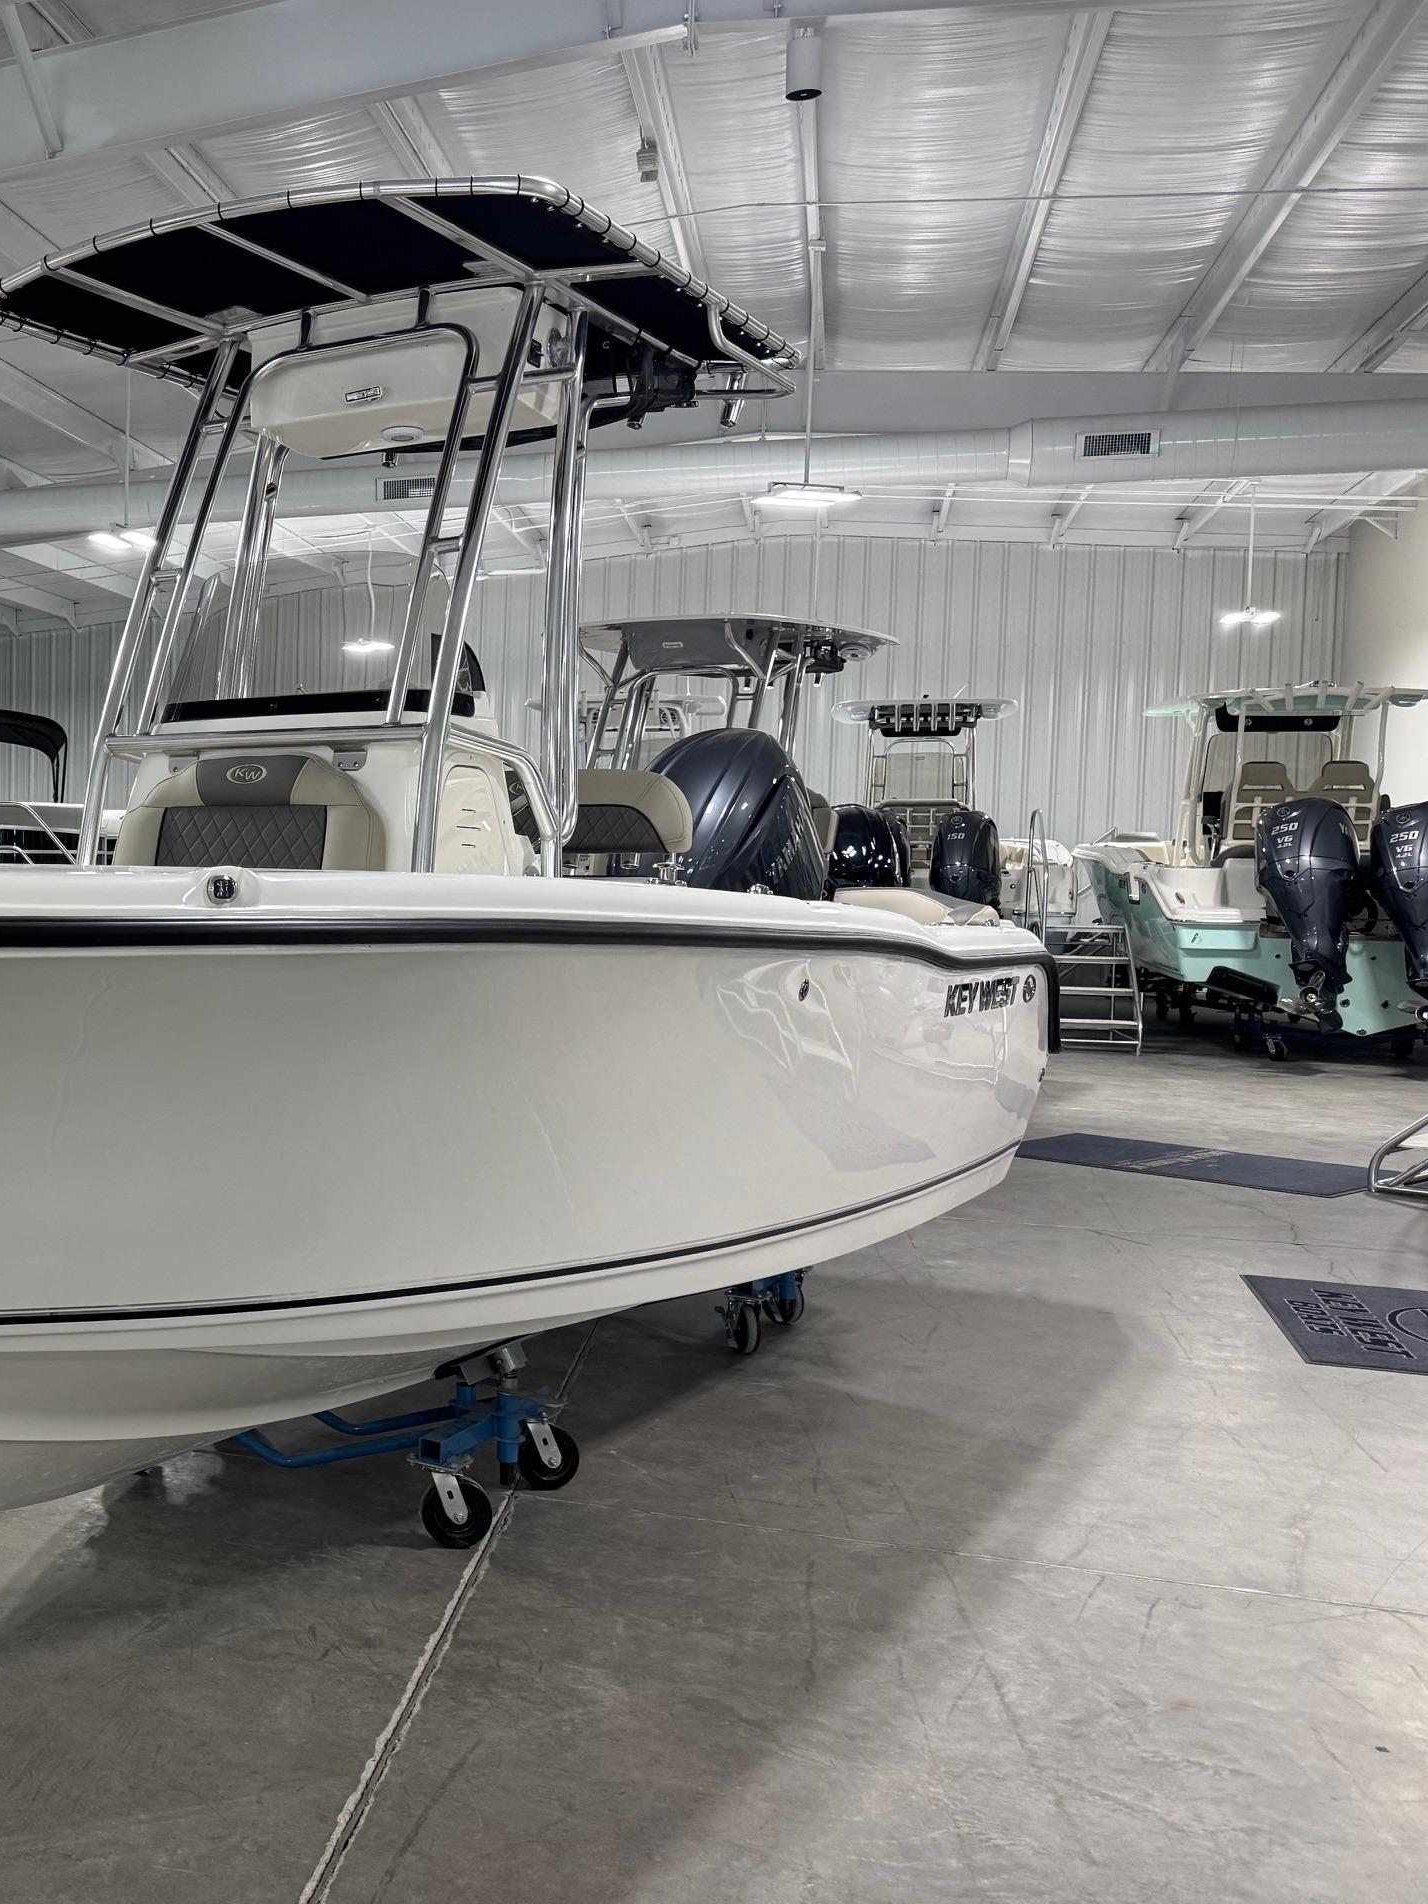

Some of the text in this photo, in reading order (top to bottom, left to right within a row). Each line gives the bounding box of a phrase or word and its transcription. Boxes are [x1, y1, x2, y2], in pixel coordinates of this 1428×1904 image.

[1271, 822, 1299, 836] 250
[946, 832, 966, 841] 150
[1277, 834, 1294, 844] V6
[1389, 830, 1420, 844] 250
[1395, 844, 1414, 853] V6
[1284, 1298, 1348, 1336] BOATS
